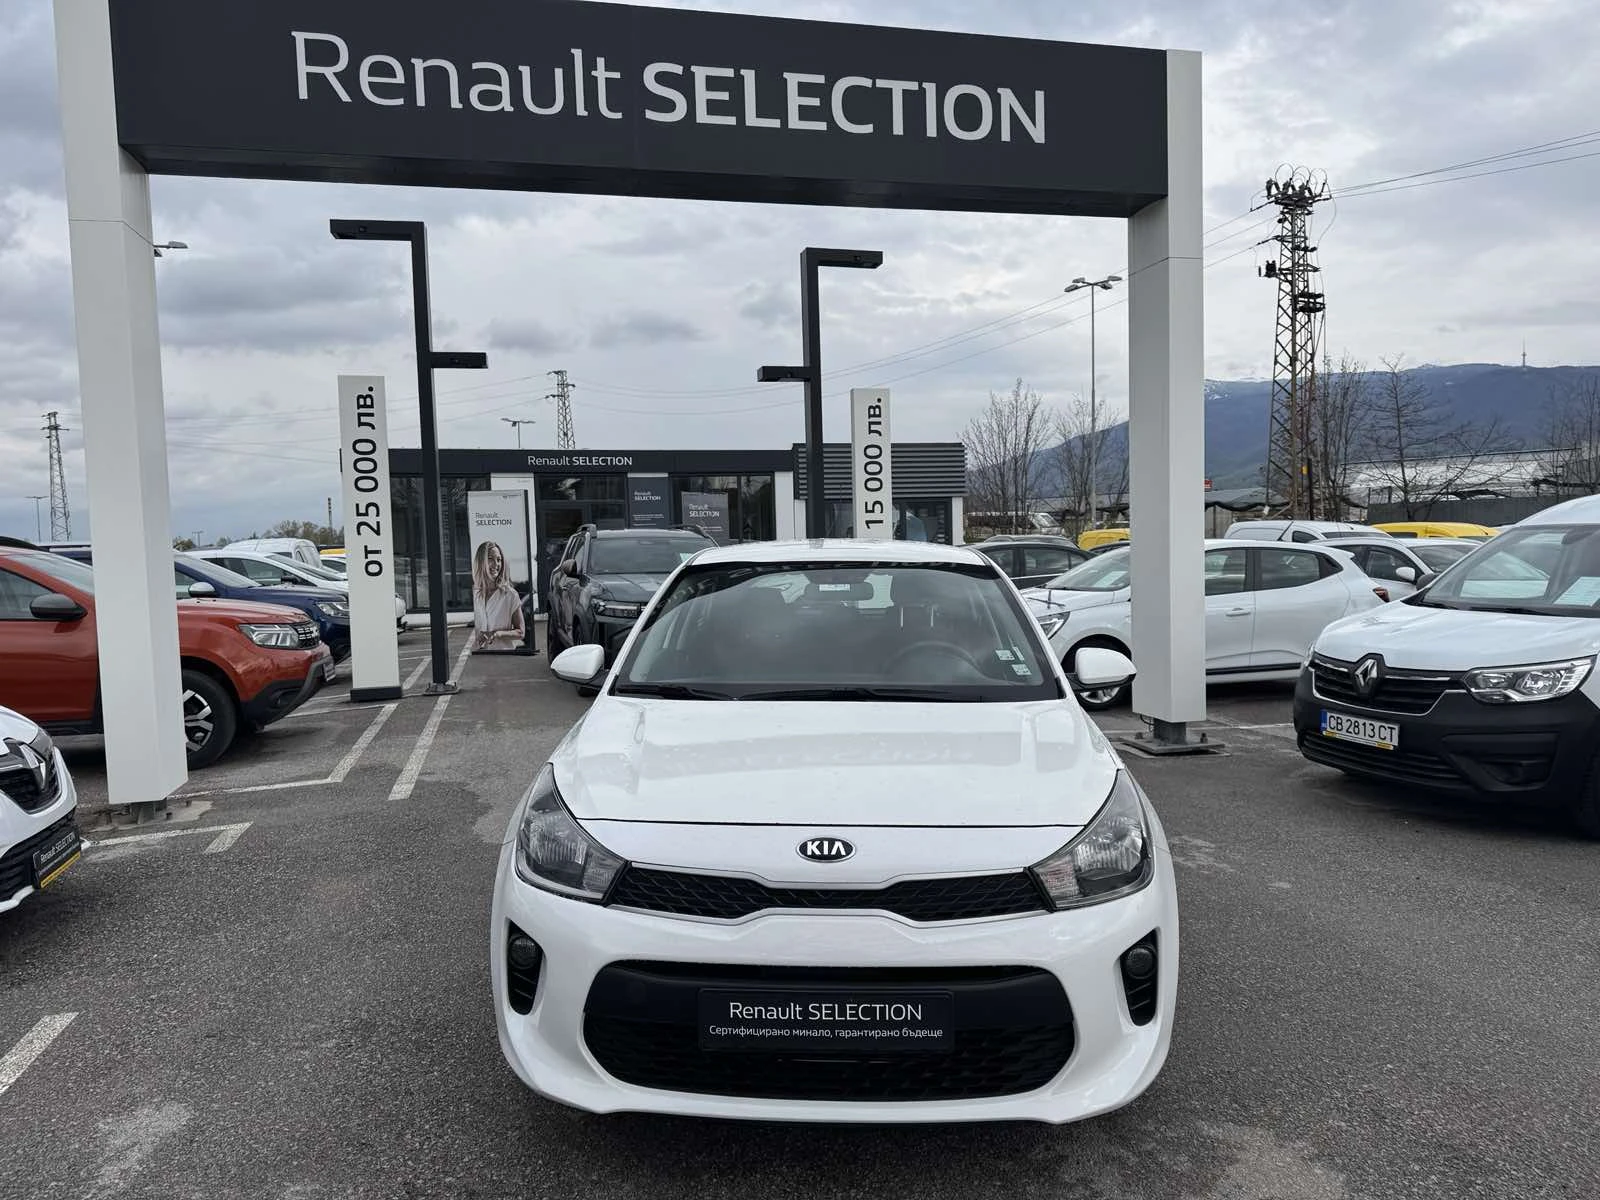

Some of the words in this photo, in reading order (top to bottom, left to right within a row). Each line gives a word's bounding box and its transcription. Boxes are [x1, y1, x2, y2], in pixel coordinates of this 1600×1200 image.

[291, 31, 623, 120] Renault
[643, 62, 1046, 144] SELECTION
[356, 385, 376, 430] лв.
[867, 397, 882, 437] лв.
[352, 438, 379, 493] 000
[527, 455, 570, 466] Renault
[572, 456, 633, 466] SELECTION
[863, 443, 883, 493] 000
[355, 501, 381, 536] 25
[864, 500, 884, 530] 15
[364, 545, 383, 577] от
[1328, 715, 1344, 731] CB
[1346, 719, 1376, 738] 2813
[1378, 725, 1396, 742] CT
[807, 840, 846, 856] KIA
[729, 1002, 803, 1020] Renault
[808, 1003, 922, 1021] SELECTION
[709, 1025, 790, 1038] Сертифицирано
[792, 1028, 833, 1039] минало,
[835, 1029, 900, 1039] гарантирано
[902, 1028, 943, 1039] бъдеще
